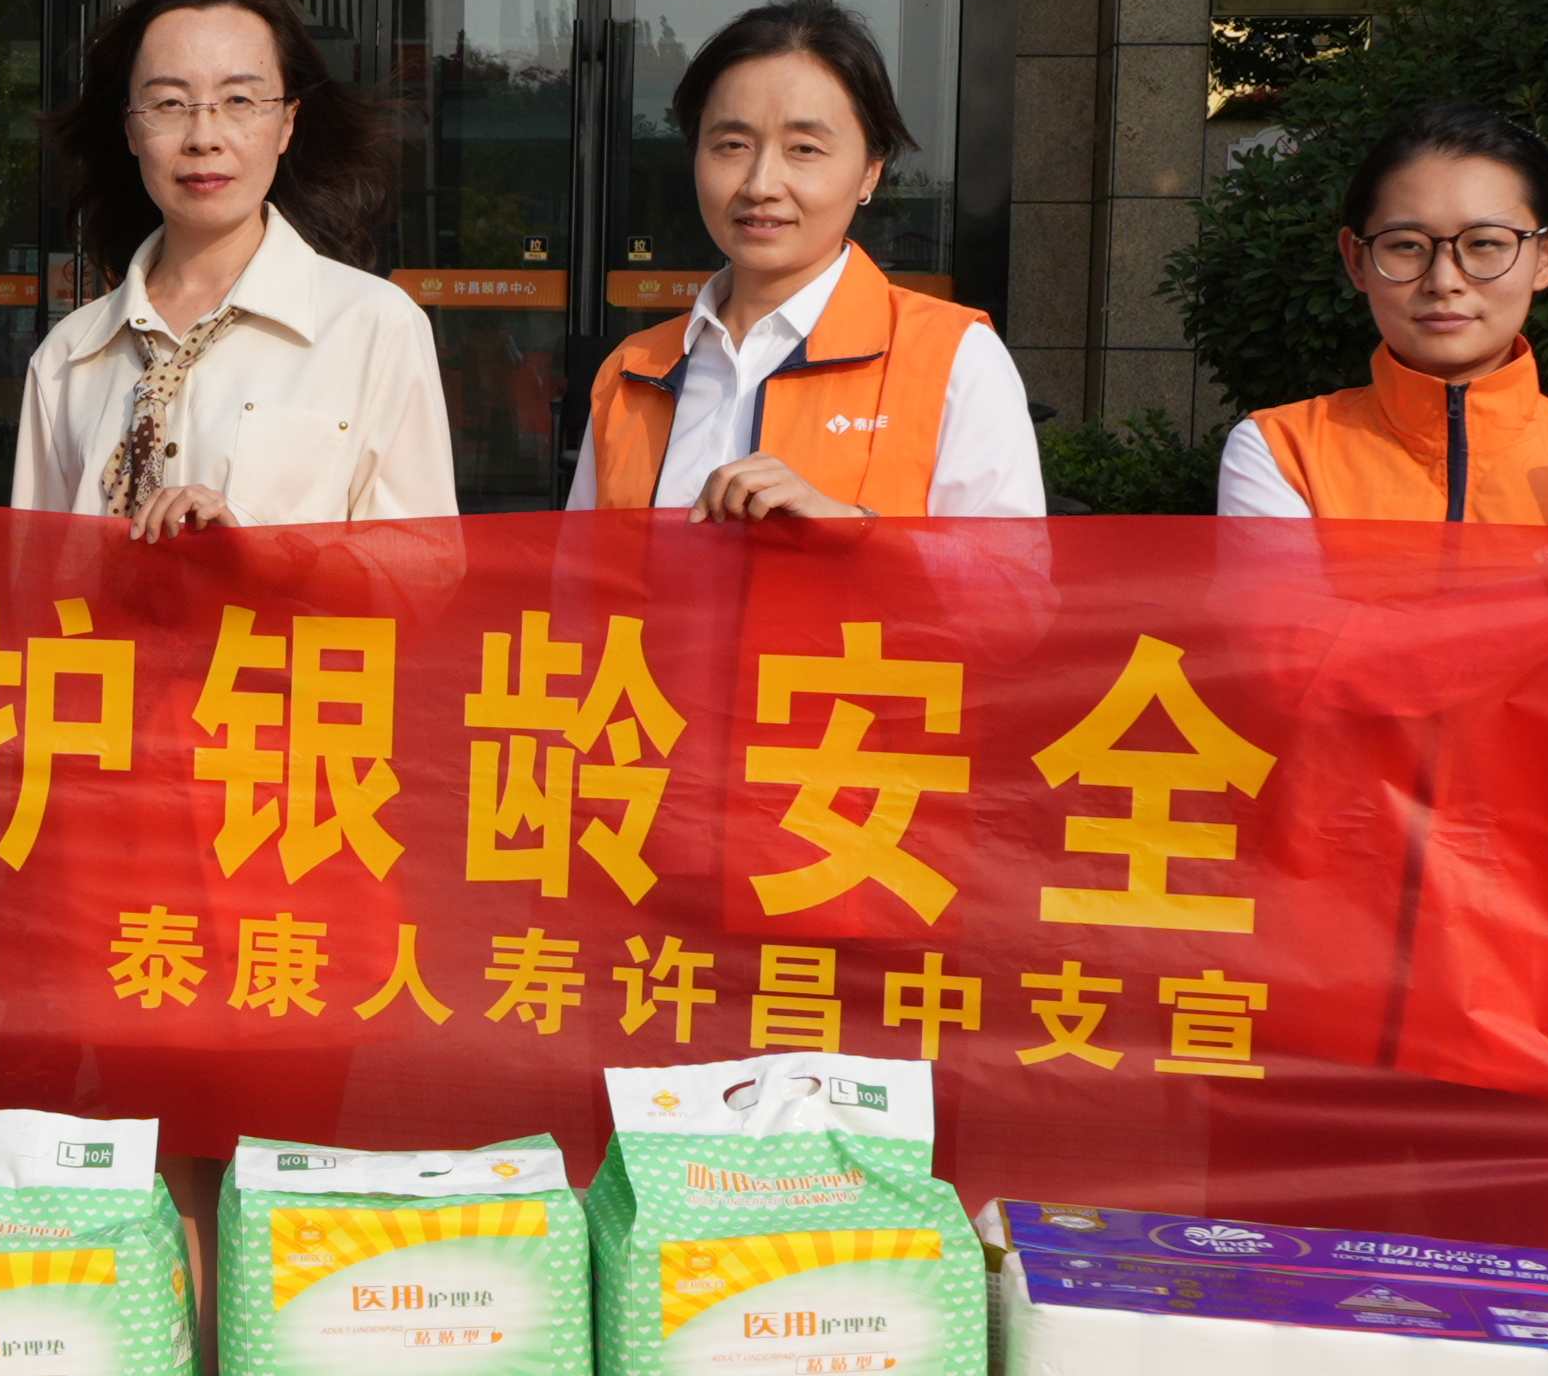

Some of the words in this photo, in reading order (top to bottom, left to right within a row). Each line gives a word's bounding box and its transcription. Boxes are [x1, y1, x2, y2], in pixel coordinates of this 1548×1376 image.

[531, 240, 542, 251] 拉
[110, 905, 1267, 1078] 泰康人寿许昌中支宣
[1185, 1235, 1274, 1253] Vinda
[1335, 1239, 1419, 1260] 超韧
[1422, 1248, 1513, 1270] Strong
[1445, 1247, 1498, 1260] Ultra
[353, 1285, 494, 1311] 医用护理垫
[744, 1311, 887, 1338] 医用护理垫
